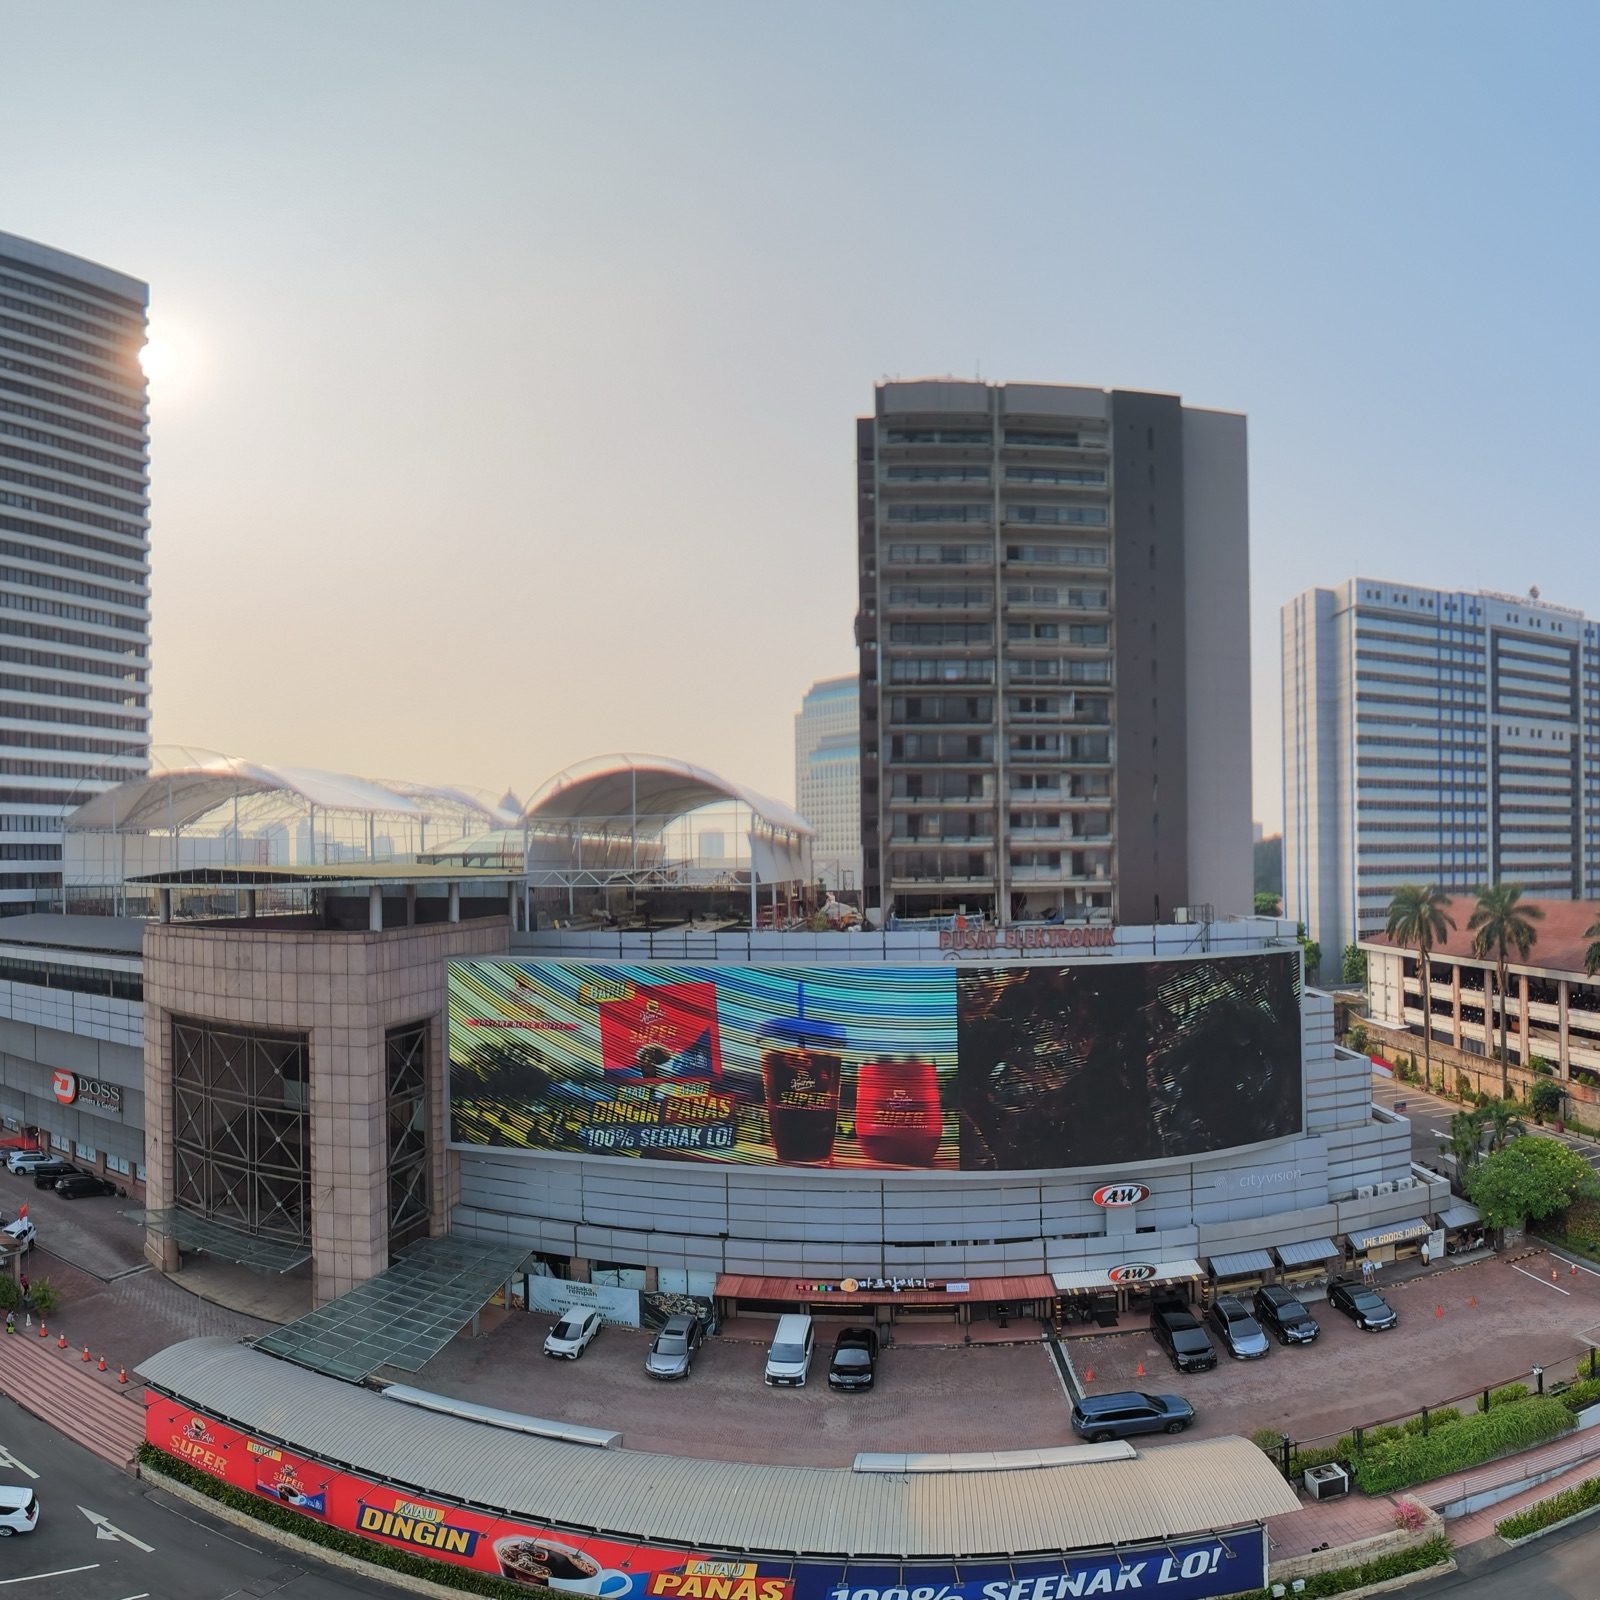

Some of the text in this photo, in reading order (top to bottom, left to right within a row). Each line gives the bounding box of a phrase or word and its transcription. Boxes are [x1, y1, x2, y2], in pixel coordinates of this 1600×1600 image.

[939, 927, 1116, 950] PUSAT ELEKTRONIK
[79, 1077, 120, 1101] DOSS
[592, 1097, 732, 1123] DINGIN PANAS
[587, 1127, 733, 1147] 100% SEENAK LO!
[1239, 1168, 1303, 1189] cityvision
[1361, 1236, 1377, 1248] THE
[1378, 1230, 1404, 1245] GOODS
[169, 1434, 228, 1472] SUPER
[273, 1471, 305, 1490] SUPER
[398, 1501, 437, 1520] MAU
[361, 1507, 470, 1553] DINGIN
[692, 1560, 746, 1577] ATAU
[981, 1546, 1223, 1600] SEENAK LO!
[652, 1573, 786, 1600] PANAS
